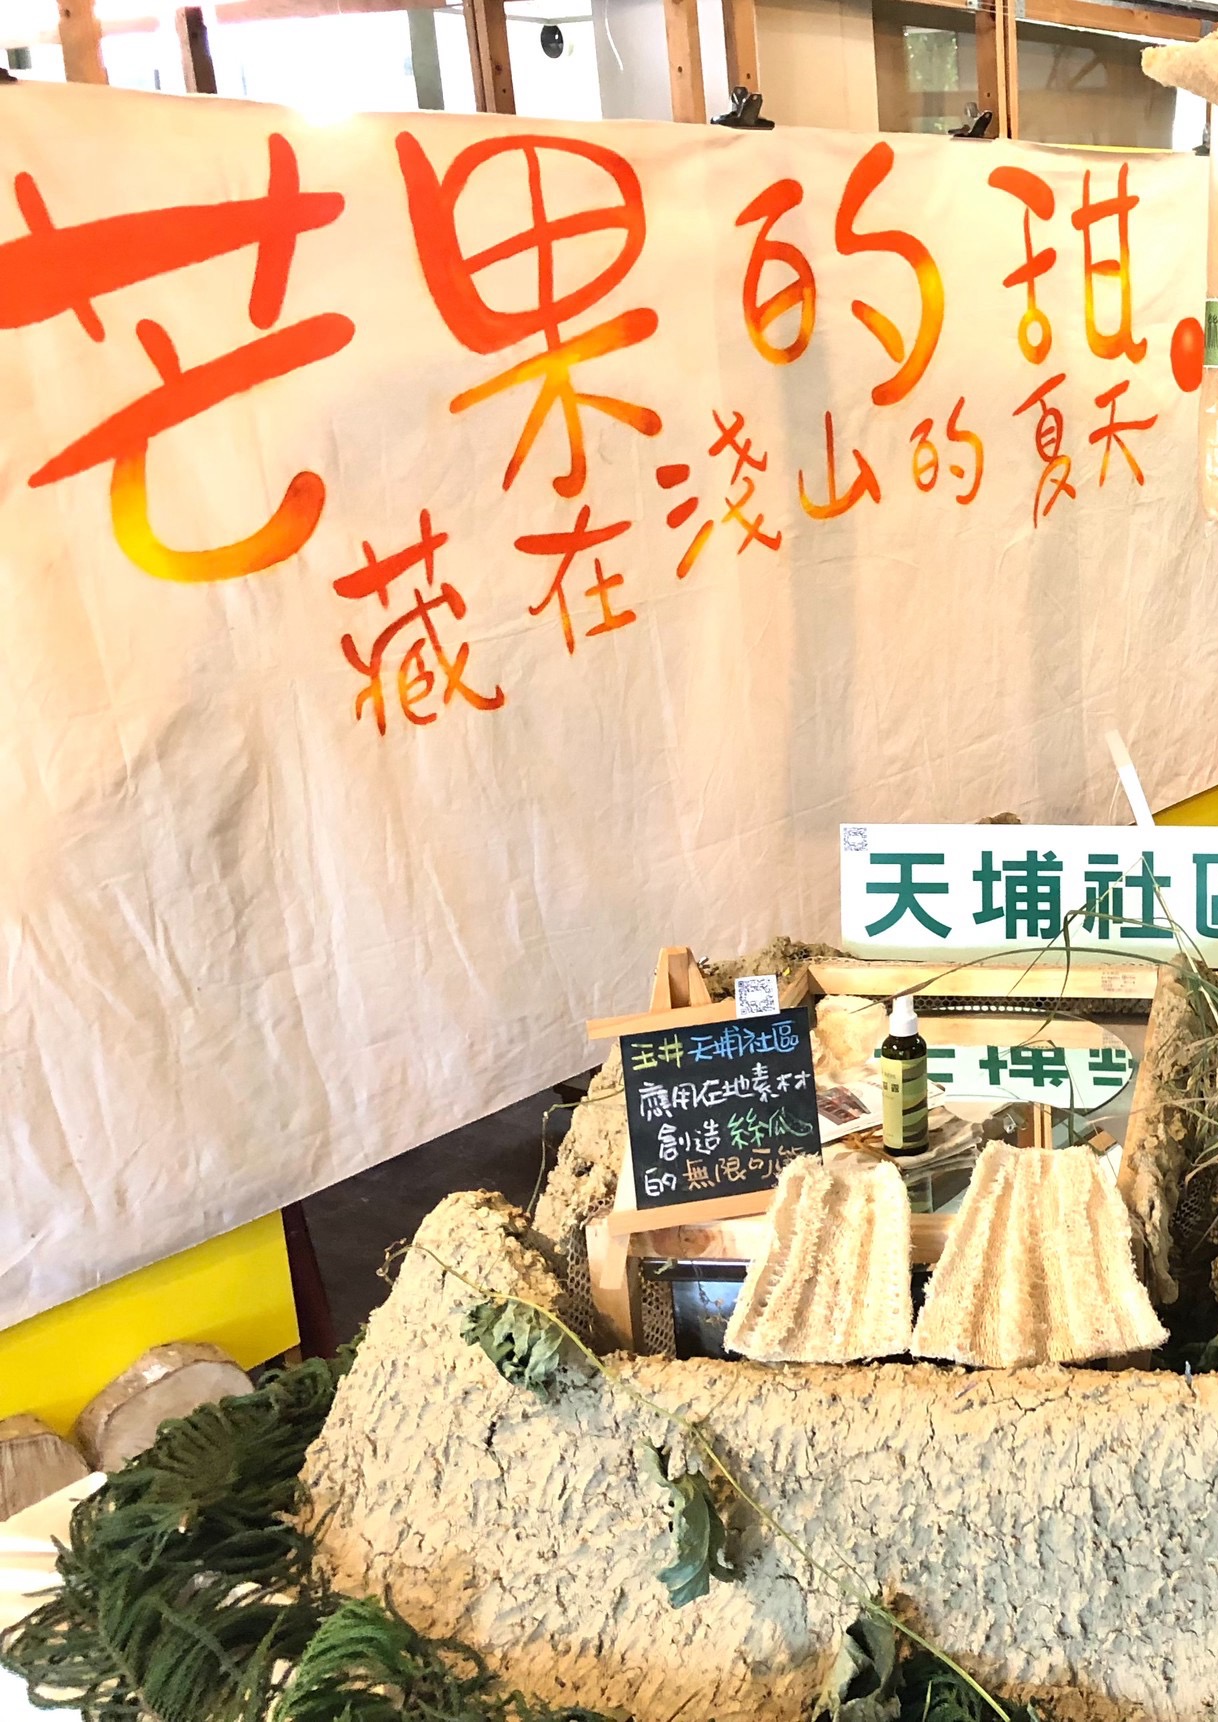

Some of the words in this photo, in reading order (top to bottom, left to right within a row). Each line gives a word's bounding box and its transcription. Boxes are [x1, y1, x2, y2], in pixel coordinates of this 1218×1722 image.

[334, 373, 1157, 736] 藏在淺山的夏天
